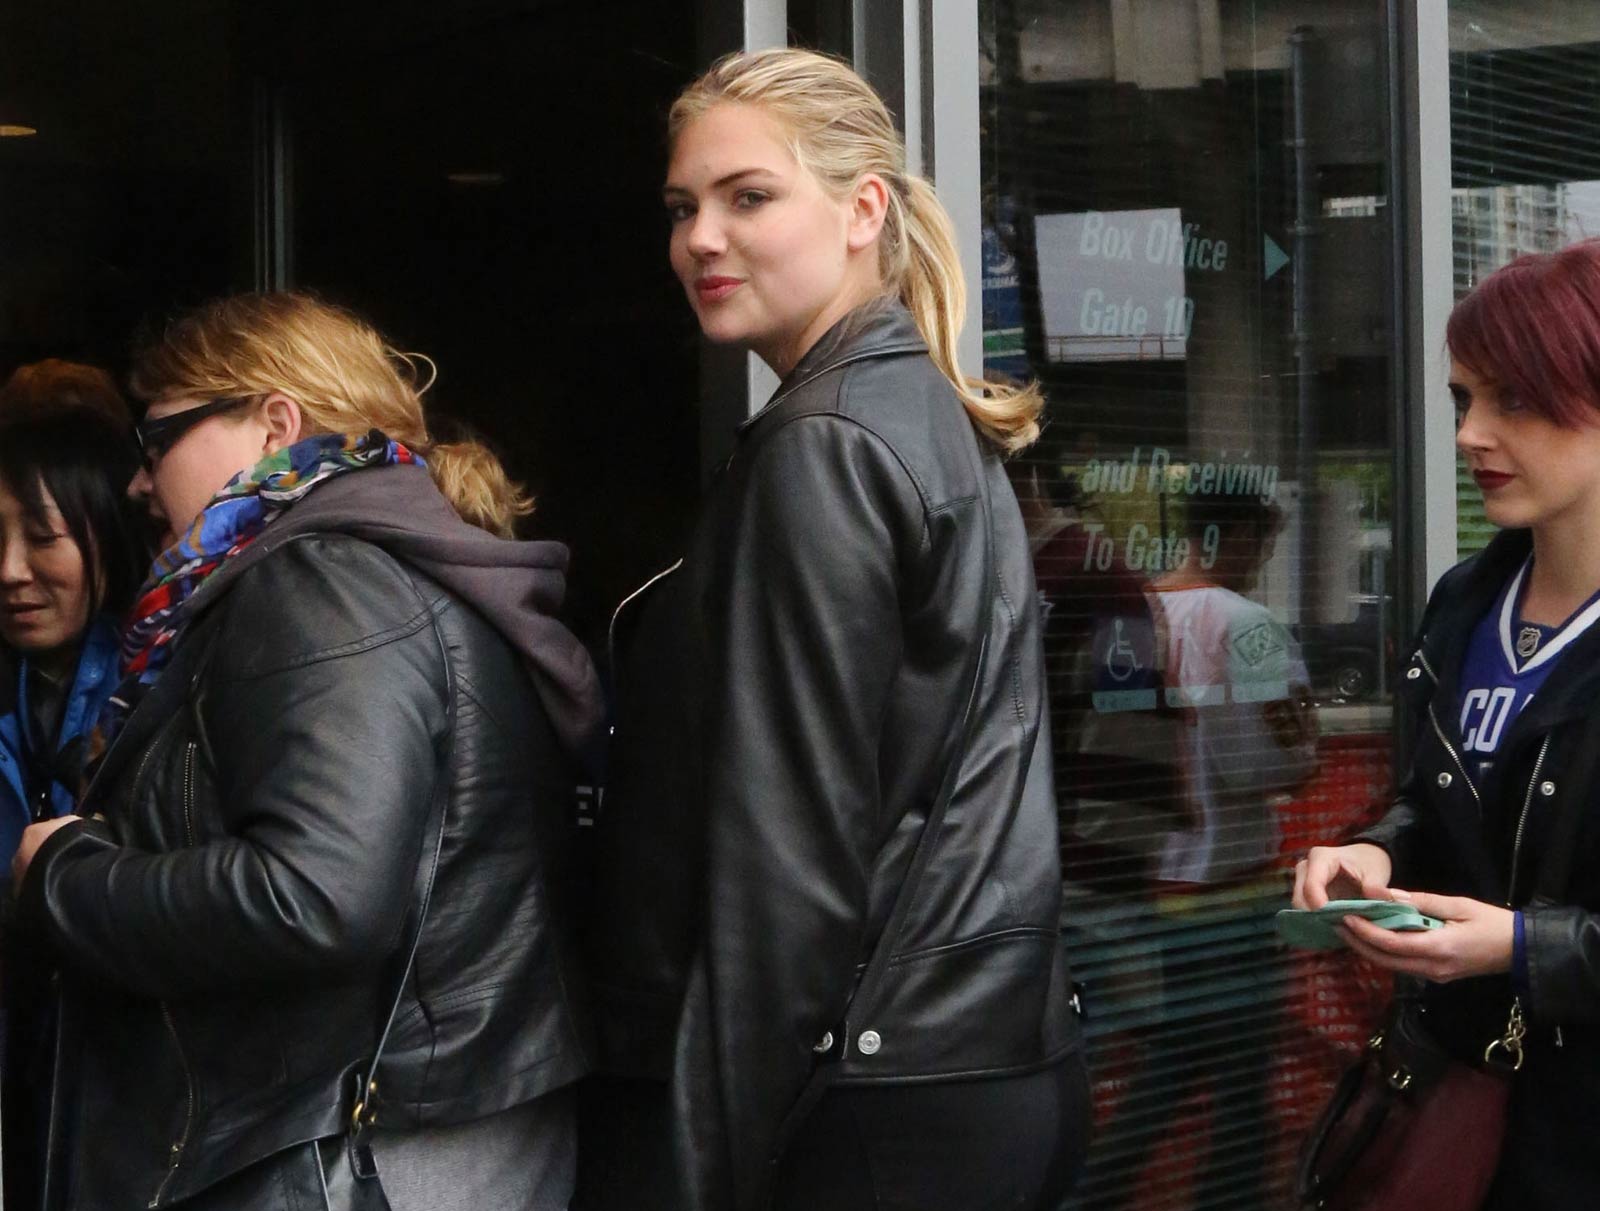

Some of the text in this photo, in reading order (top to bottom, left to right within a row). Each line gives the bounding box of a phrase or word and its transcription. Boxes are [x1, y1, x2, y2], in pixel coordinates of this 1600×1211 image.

[1079, 210, 1228, 272] Box Office
[1080, 287, 1195, 344] Gate 10
[1082, 446, 1279, 506] and Receiving
[1083, 523, 1221, 573] To Gate 9
[1460, 686, 1534, 753] CO
